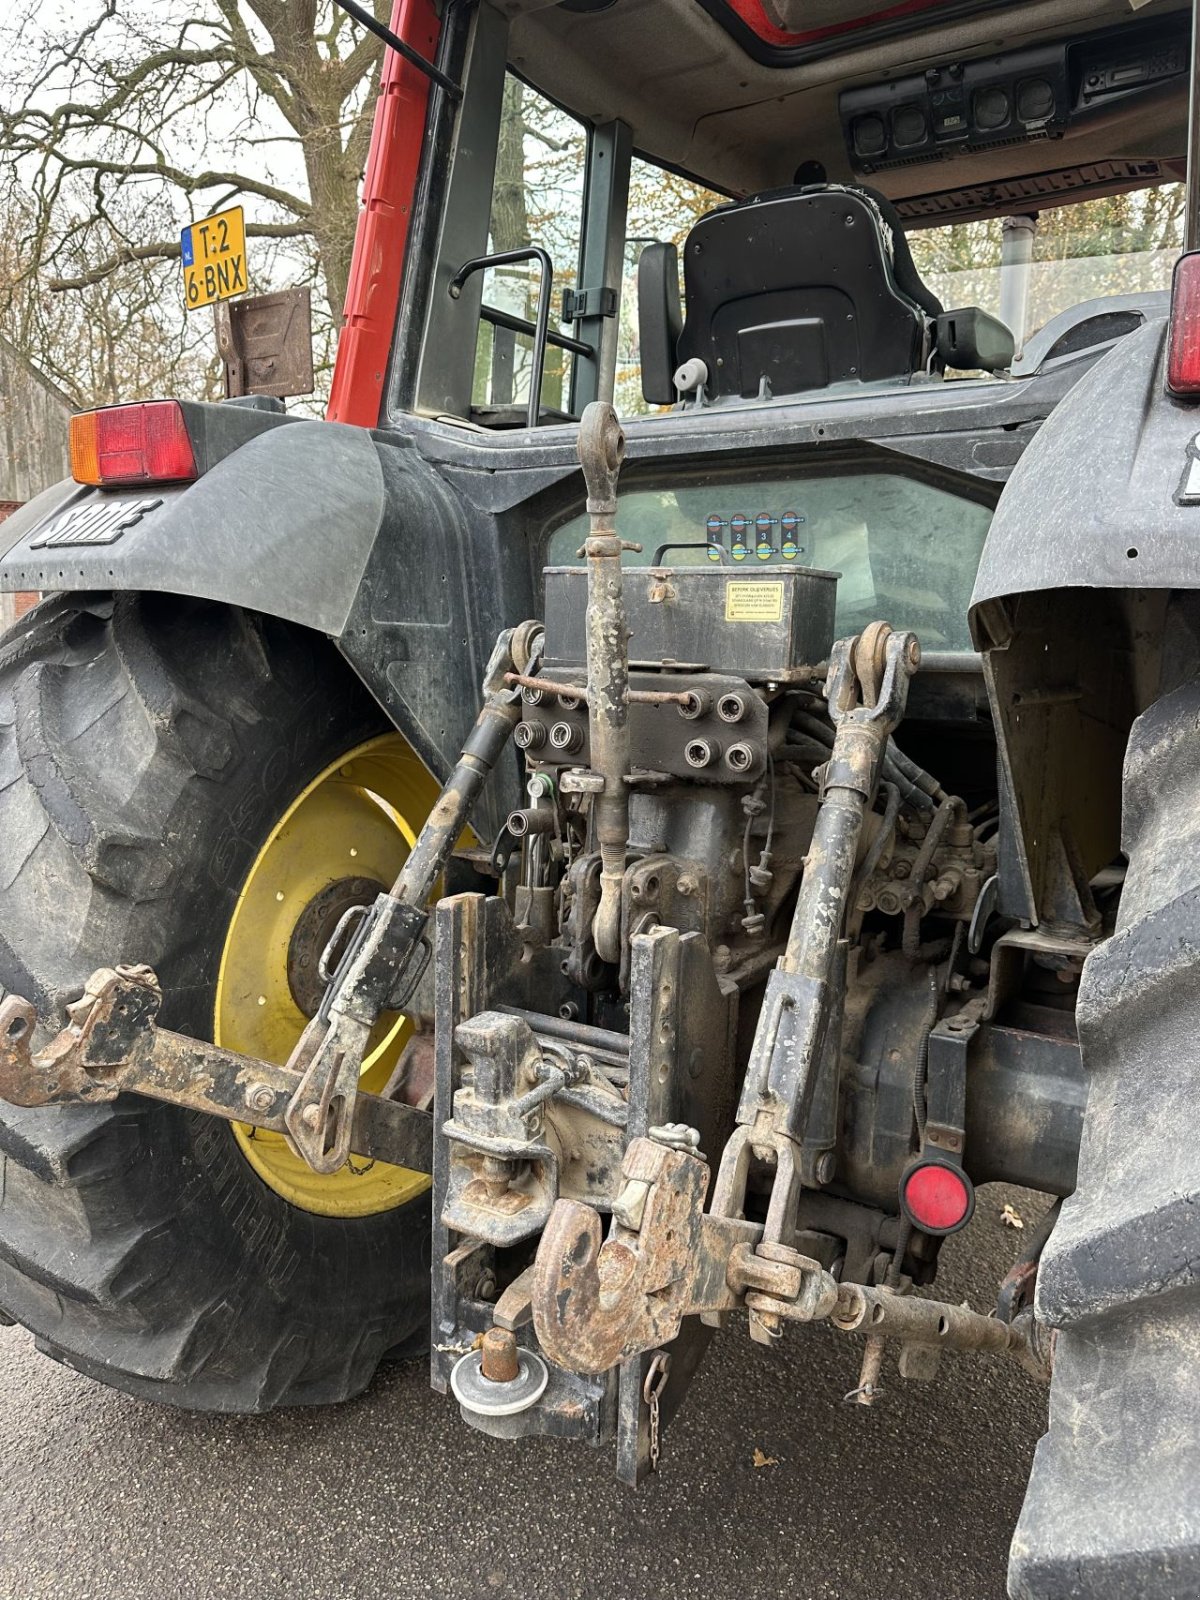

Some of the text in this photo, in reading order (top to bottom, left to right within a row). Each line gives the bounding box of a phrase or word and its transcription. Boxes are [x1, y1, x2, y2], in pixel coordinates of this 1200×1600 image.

[188, 254, 244, 303] 6-BNX
[711, 531, 792, 542] 1 2 3 4
